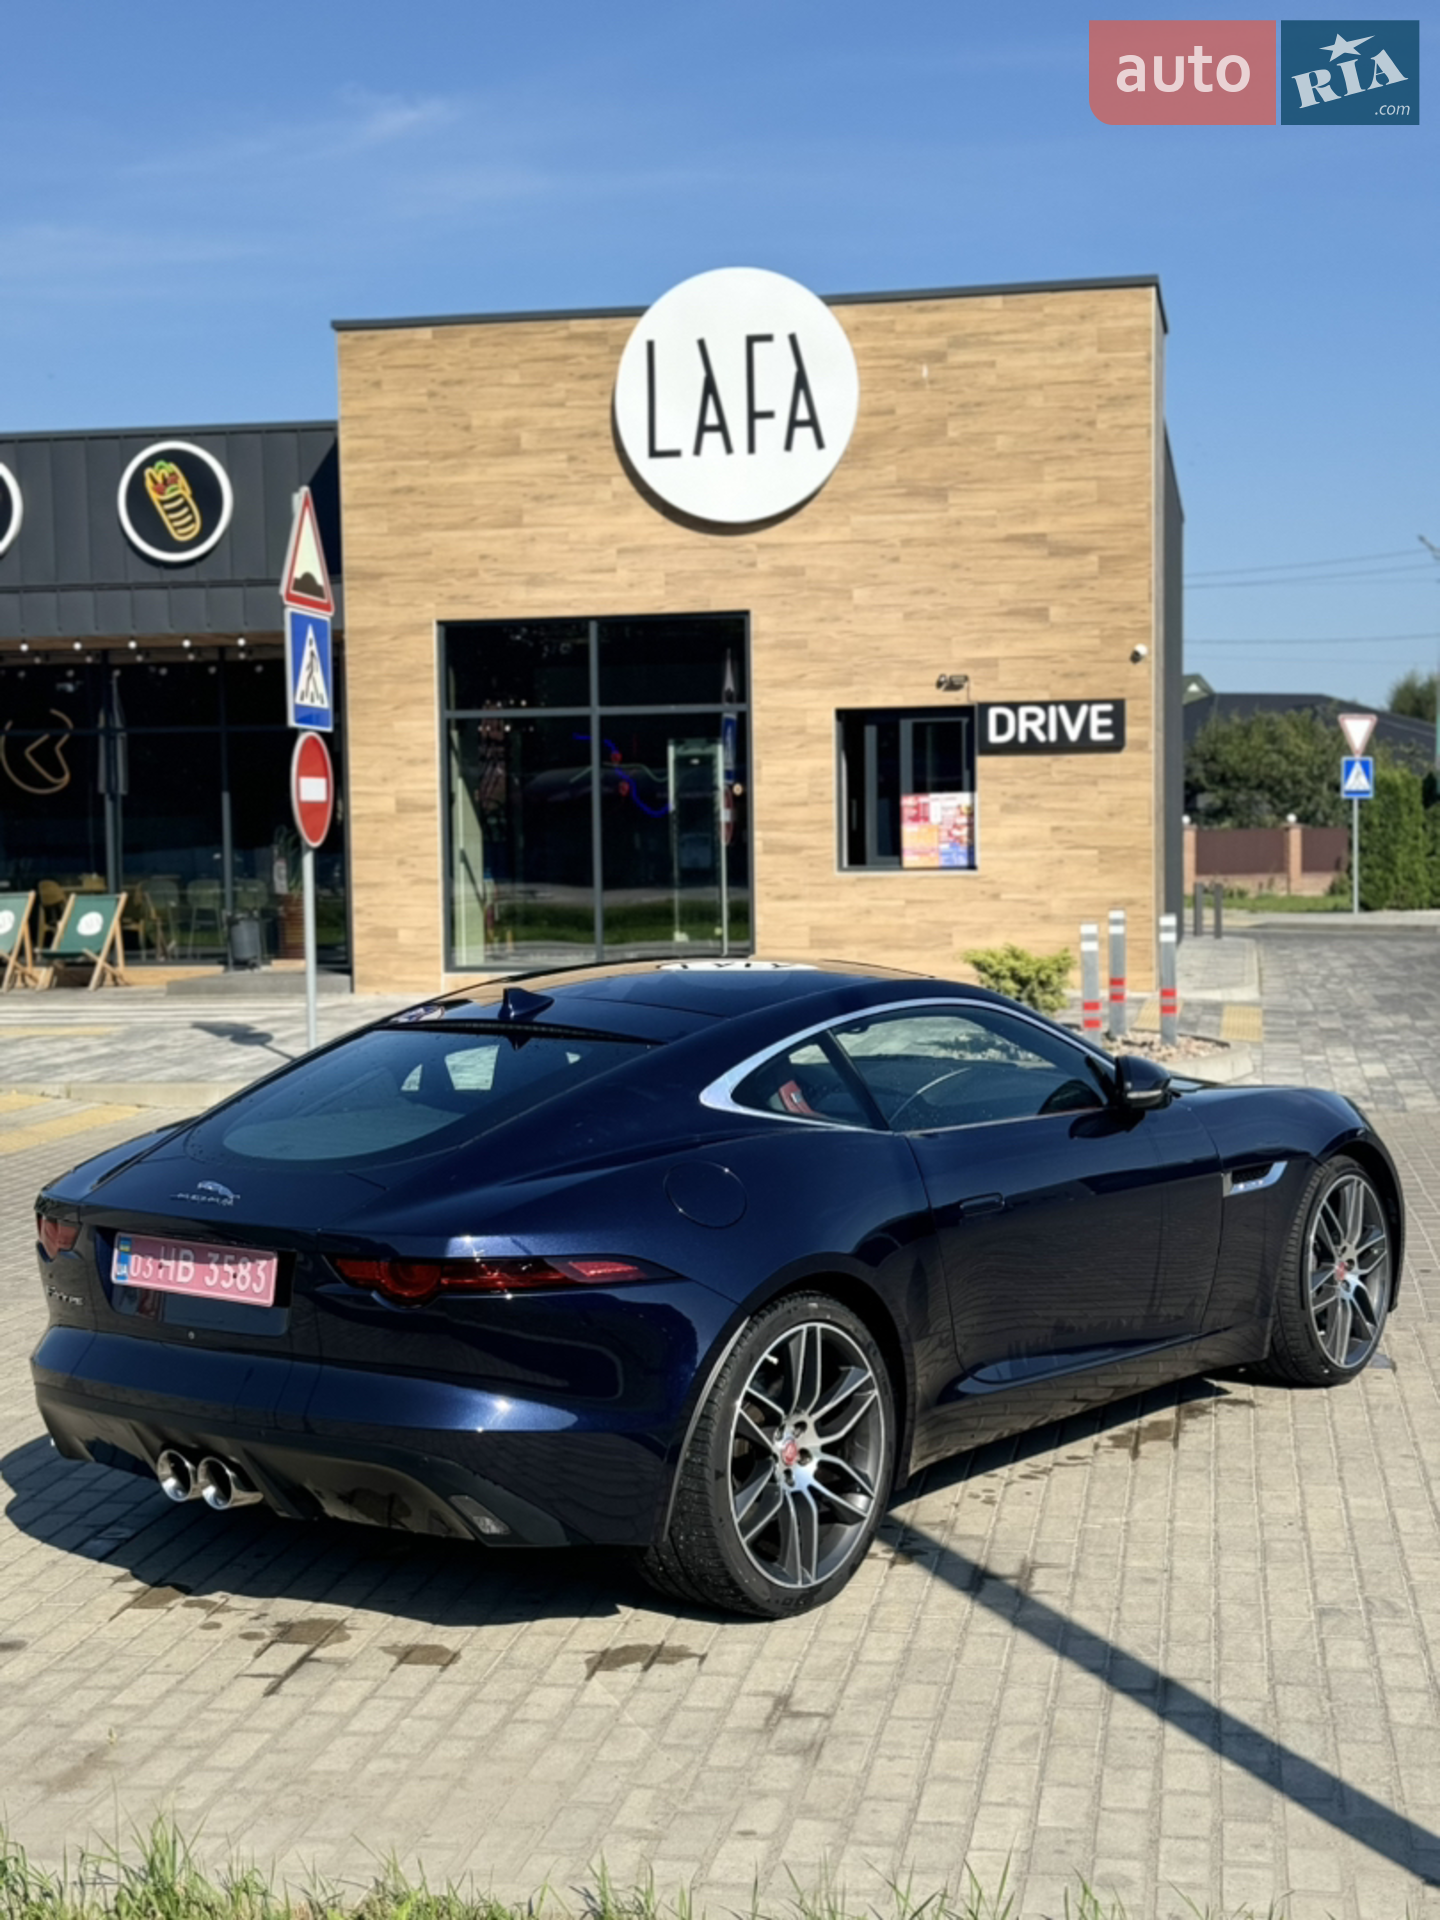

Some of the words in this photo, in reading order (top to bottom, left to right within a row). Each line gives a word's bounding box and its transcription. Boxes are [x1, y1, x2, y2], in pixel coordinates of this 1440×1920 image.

[646, 332, 826, 459] LAFA
[988, 703, 1115, 744] DRIVE
[204, 1252, 269, 1294] 3583
